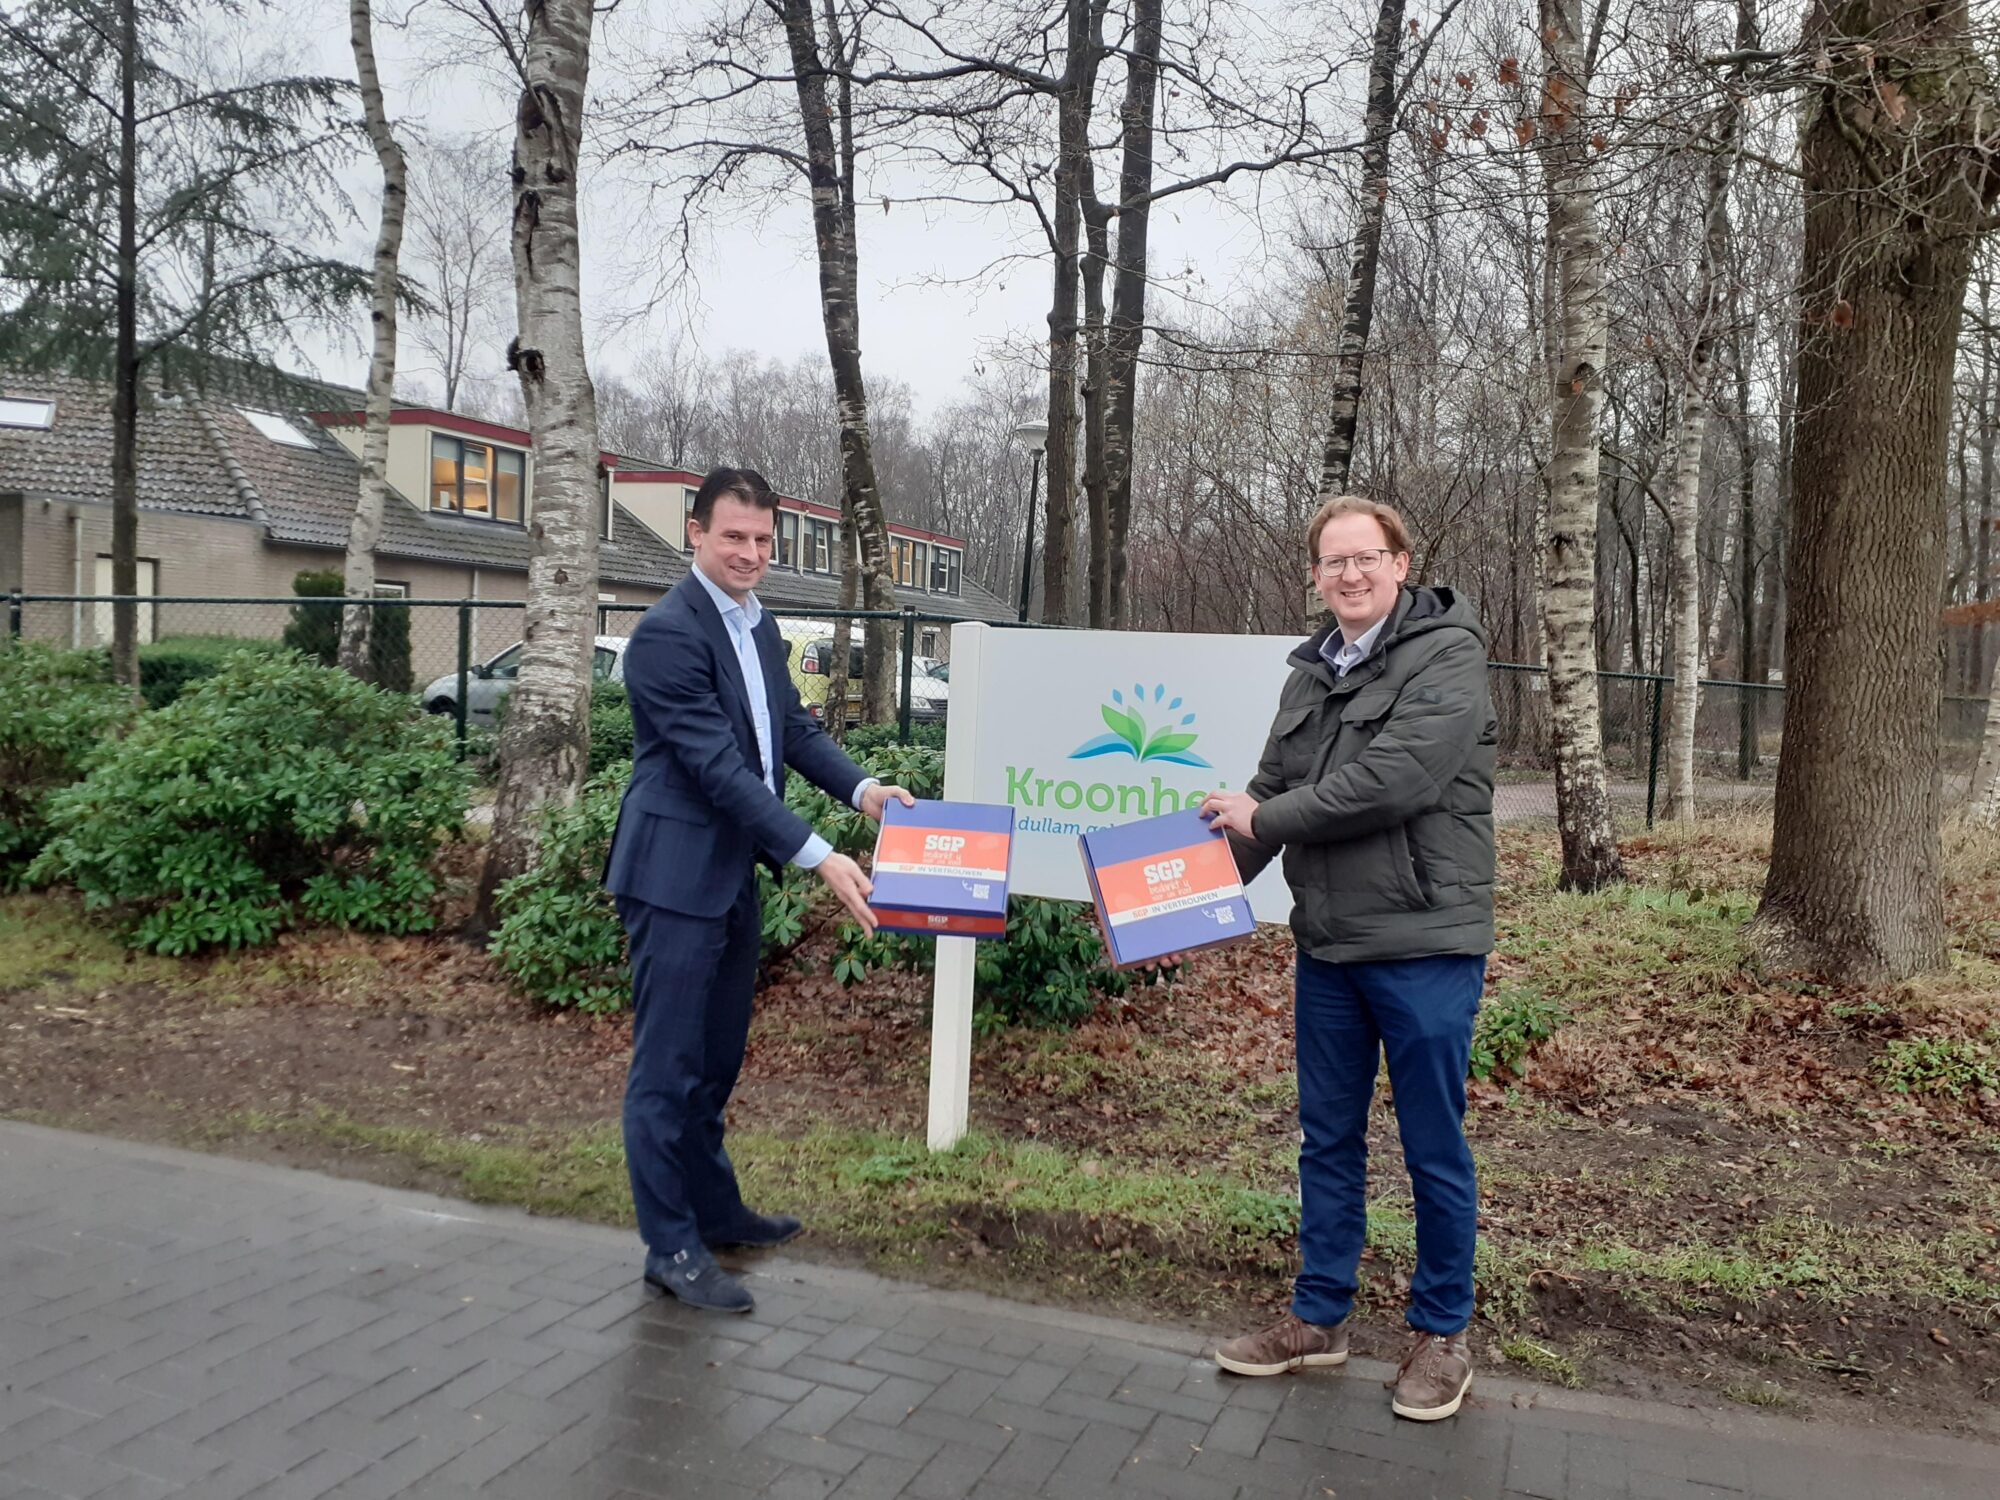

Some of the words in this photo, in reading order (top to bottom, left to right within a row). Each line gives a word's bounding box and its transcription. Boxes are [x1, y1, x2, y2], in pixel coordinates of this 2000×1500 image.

[1006, 766, 1226, 817] Kroonhe
[1015, 816, 1081, 835] dullam
[925, 834, 966, 853] SGP
[898, 864, 914, 872] SGP
[928, 866, 983, 877] VERTROUWEN
[1143, 858, 1186, 885] SGP
[1132, 908, 1149, 919] SGP
[1151, 905, 1161, 914] IN
[1162, 891, 1218, 910] VERTROUWEN
[928, 914, 948, 924] SGP
